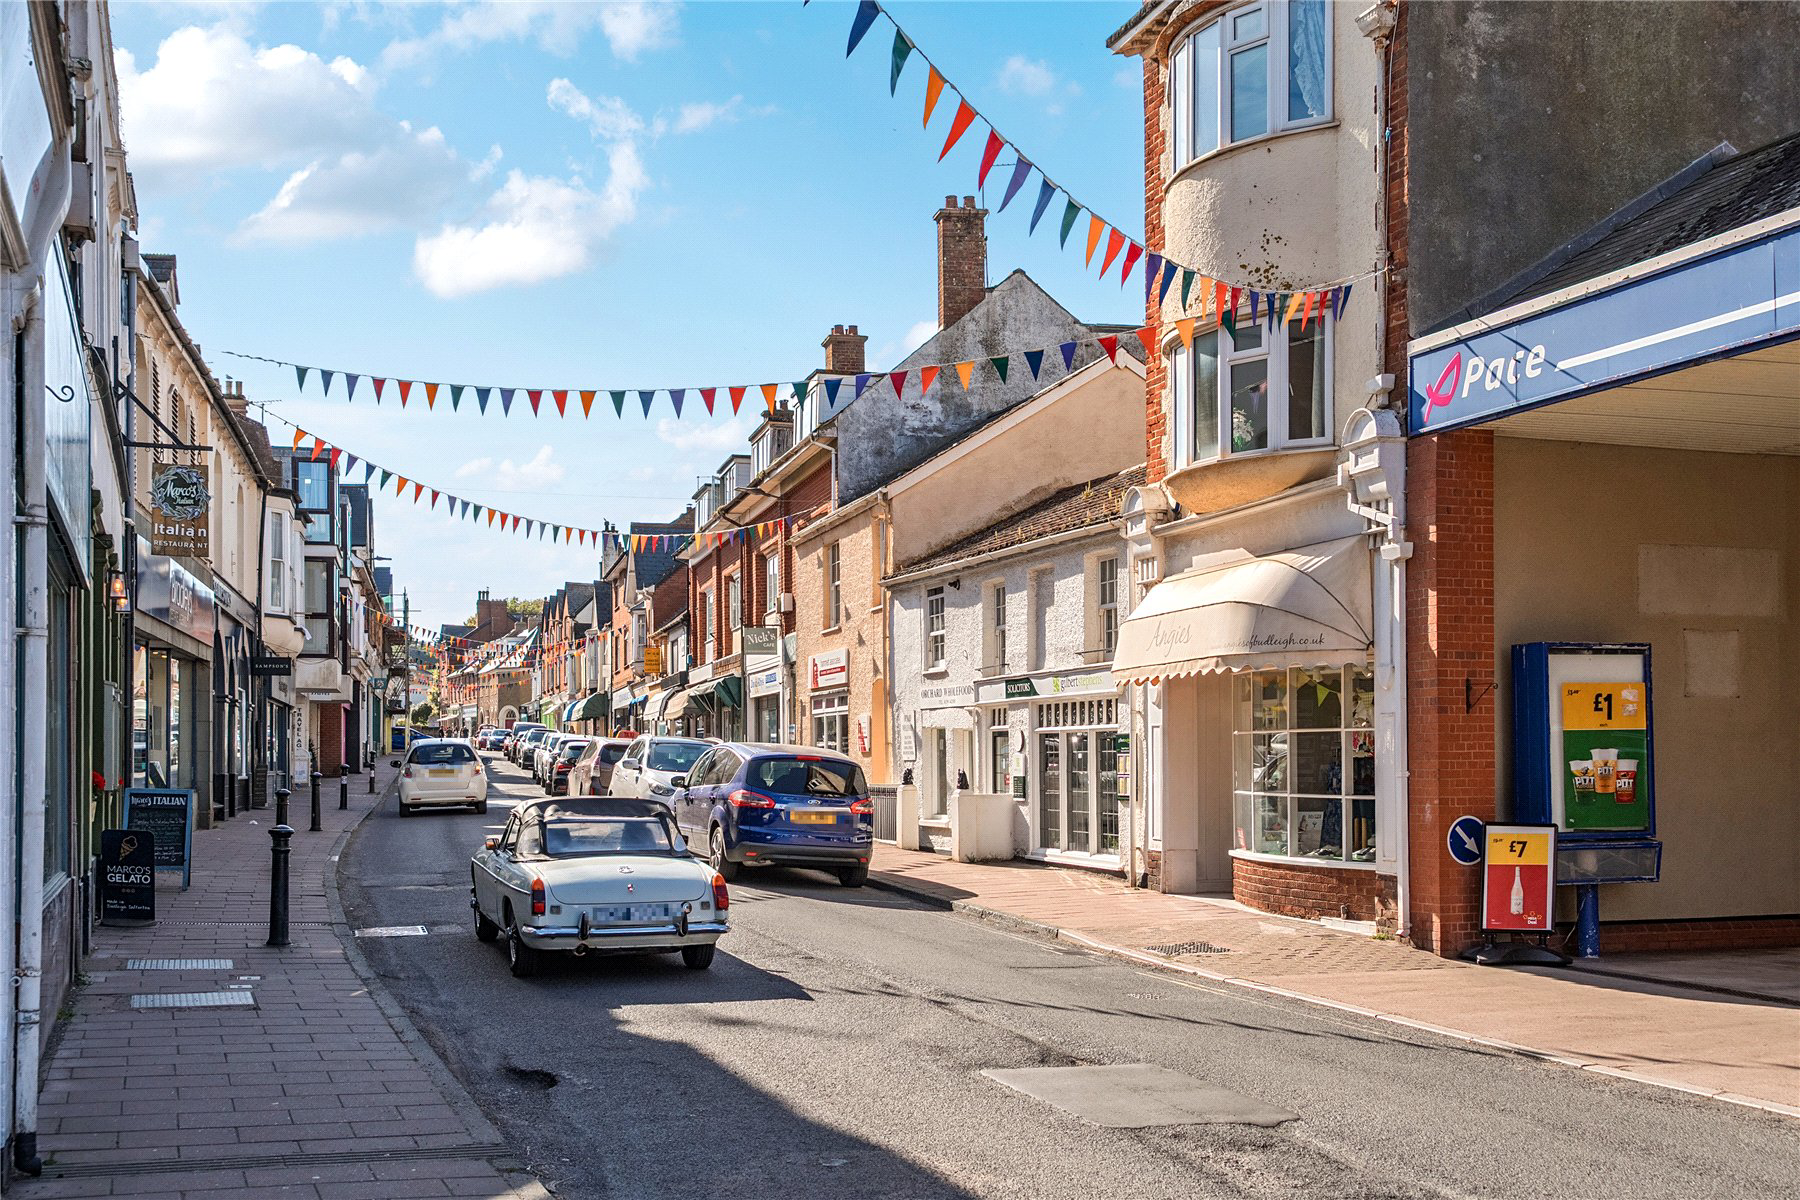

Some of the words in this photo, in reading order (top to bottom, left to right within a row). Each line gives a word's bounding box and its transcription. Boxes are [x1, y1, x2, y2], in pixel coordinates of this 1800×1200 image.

[1461, 344, 1546, 398] Pace
[163, 479, 197, 499] Marco's
[154, 523, 207, 537] Italian
[153, 540, 208, 548] RESTAURANT
[746, 630, 776, 645] Nick's
[1146, 620, 1193, 657] Angies
[920, 688, 943, 699] ORCHARD
[943, 685, 975, 697] WHOLEFOODS
[1007, 683, 1031, 693] SOLICITORS
[1593, 692, 1613, 720] £1
[1597, 766, 1614, 775] POT
[1575, 776, 1594, 785] POT
[1616, 779, 1633, 788] POT
[153, 796, 187, 806] ITALIAN
[1509, 840, 1528, 858] £7
[107, 865, 151, 875] MARCO'S
[106, 873, 151, 884] GELATO
